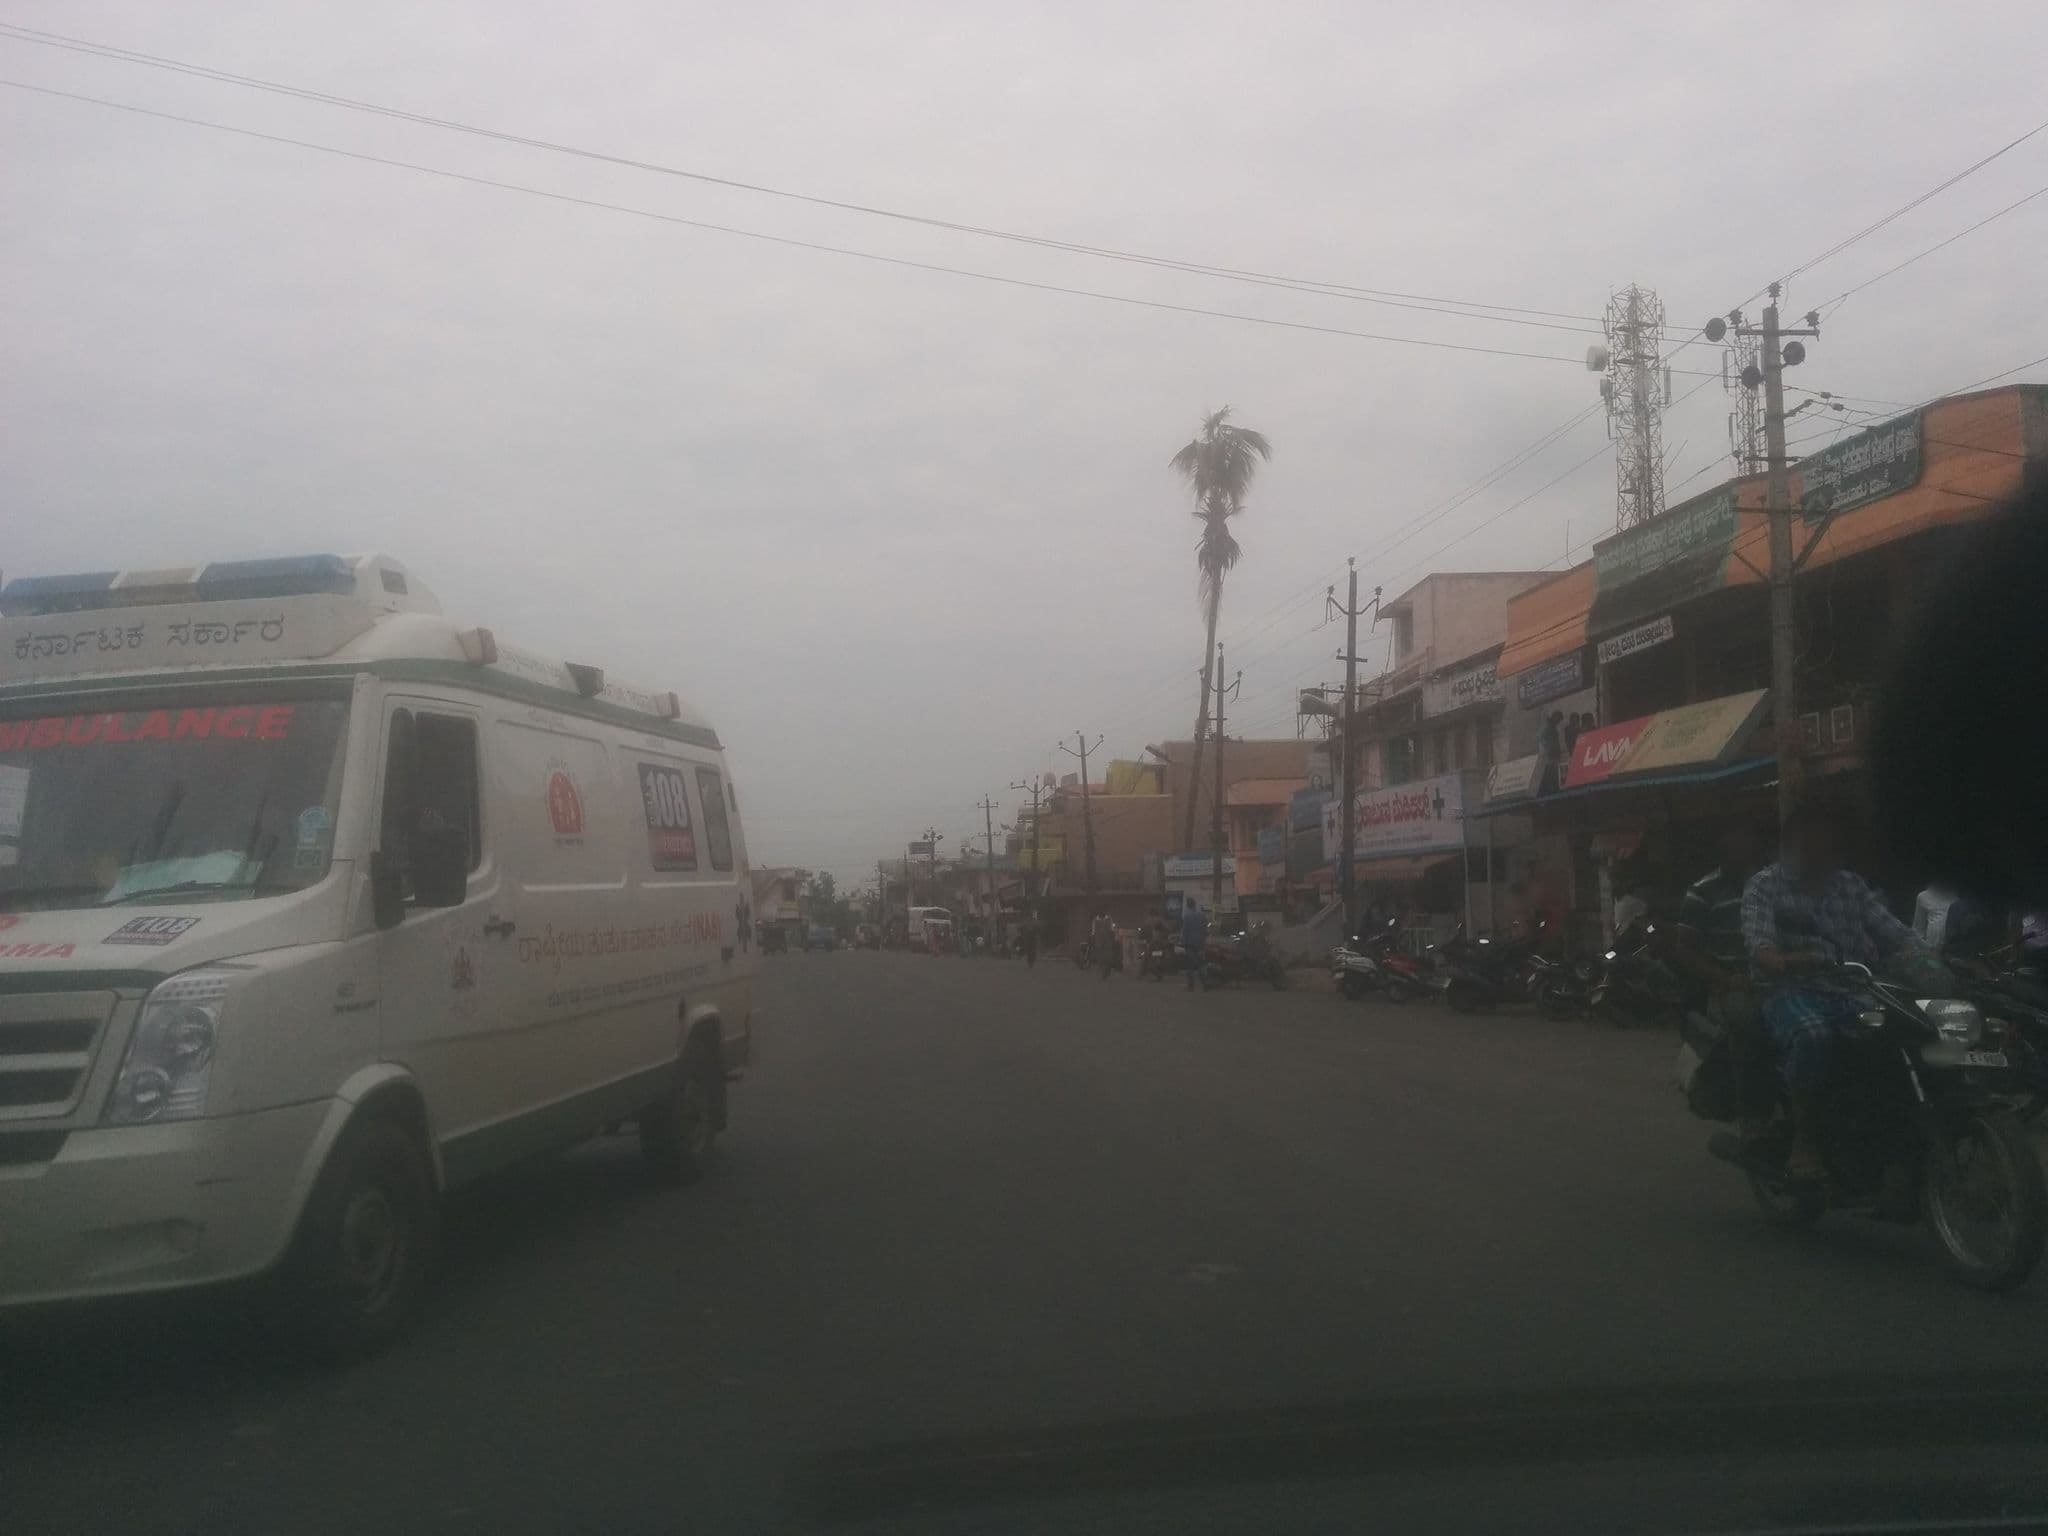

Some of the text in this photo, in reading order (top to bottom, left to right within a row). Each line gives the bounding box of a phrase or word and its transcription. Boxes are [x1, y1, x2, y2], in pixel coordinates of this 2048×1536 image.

[15, 613, 285, 660] ಕರ್ನಾಟಕ ಸರ್ಕಾರ
[1583, 737, 1633, 767] LAVA
[646, 770, 688, 828] 108
